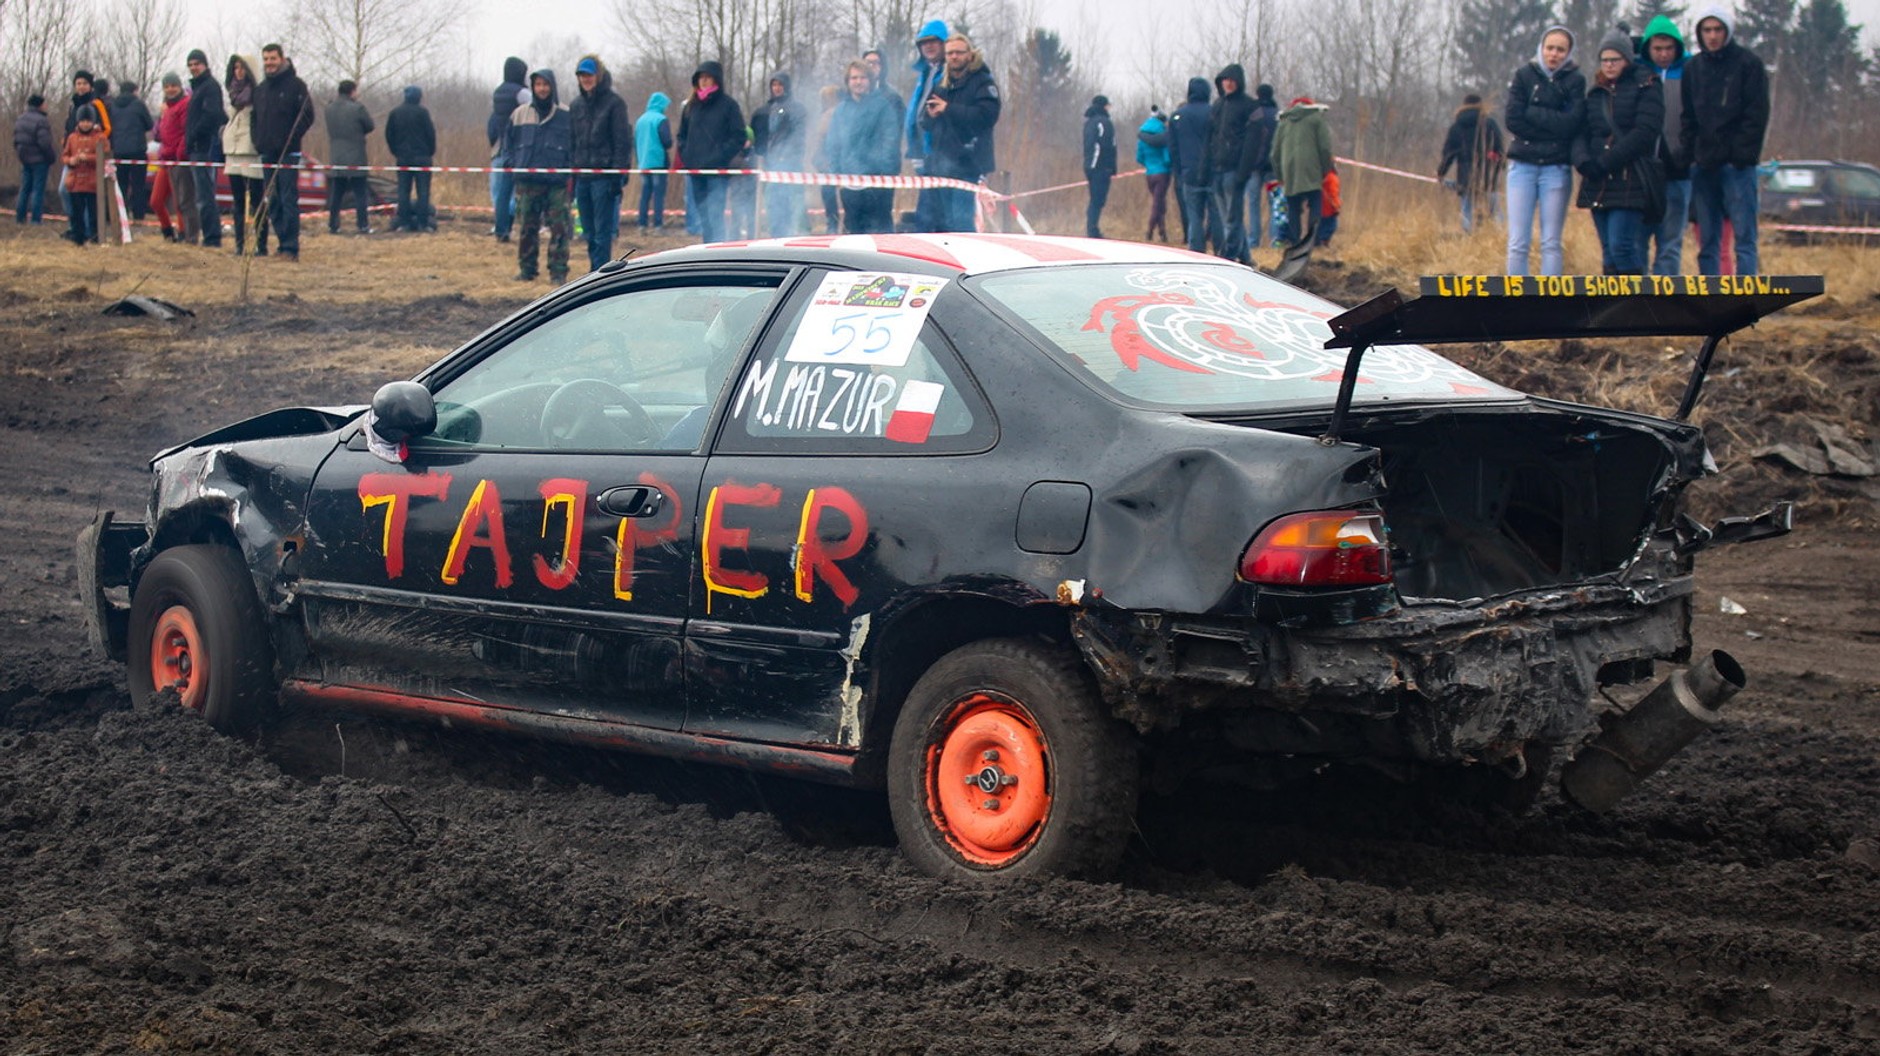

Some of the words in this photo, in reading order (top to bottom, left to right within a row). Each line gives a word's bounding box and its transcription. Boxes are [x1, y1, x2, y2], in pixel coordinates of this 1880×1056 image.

[1437, 275, 1490, 297] LIFE
[1503, 275, 1524, 297] IS
[1534, 275, 1576, 297] TOO
[1584, 274, 1643, 296] SHORT
[1650, 275, 1675, 296] TO
[1685, 275, 1709, 296] BE
[1719, 274, 1791, 295] SLOW...
[824, 313, 904, 356] 55
